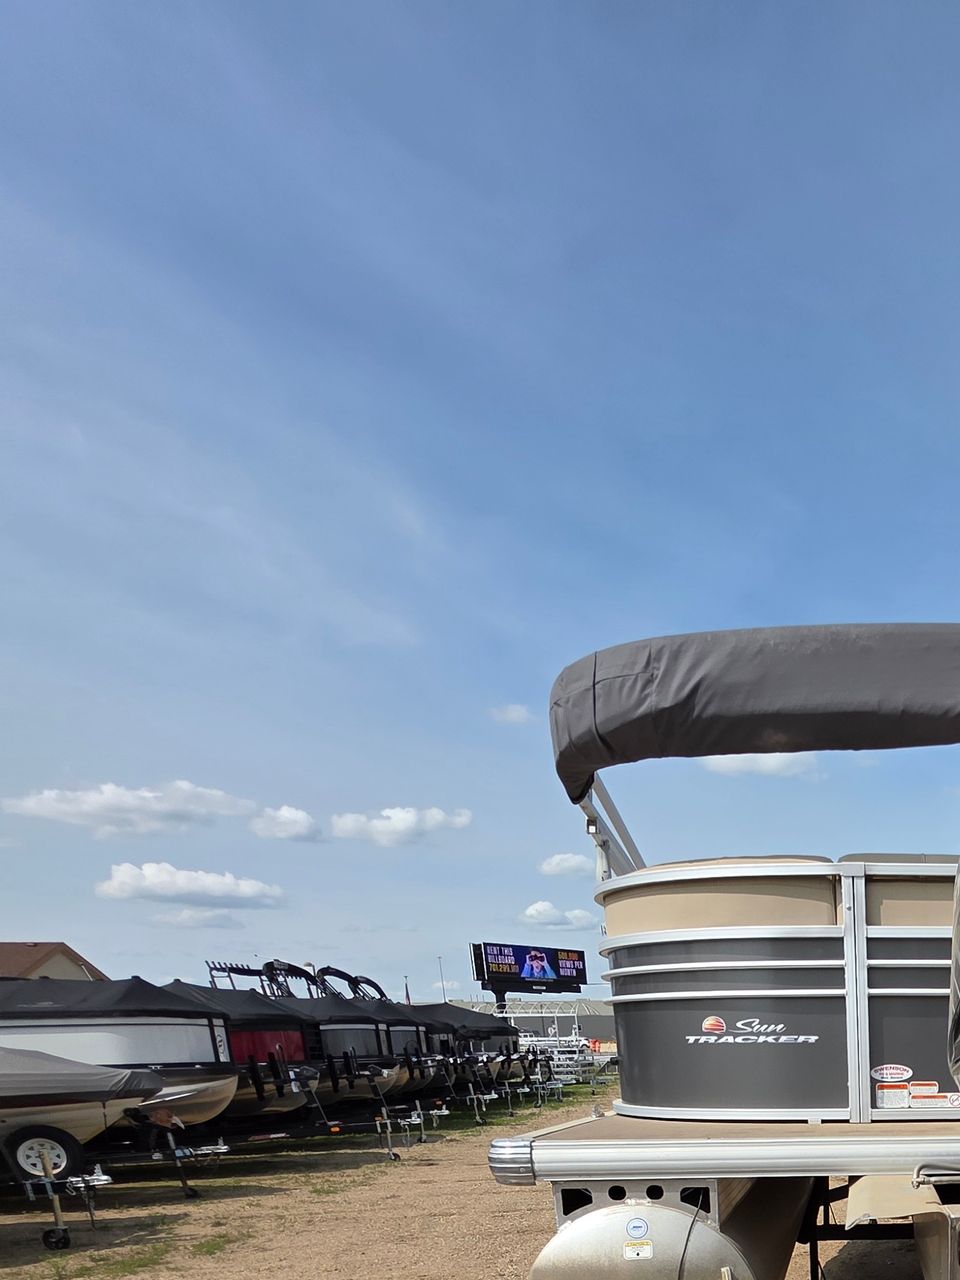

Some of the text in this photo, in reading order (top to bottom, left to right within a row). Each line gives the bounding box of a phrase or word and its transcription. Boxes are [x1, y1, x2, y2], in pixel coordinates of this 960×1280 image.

[501, 947, 513, 956] THIS
[488, 954, 515, 965] BILLBOARD
[558, 960, 583, 969] VIEWS PER
[559, 968, 577, 977] MONTH
[728, 1017, 787, 1034] Sun
[685, 1035, 819, 1044] TRACKER
